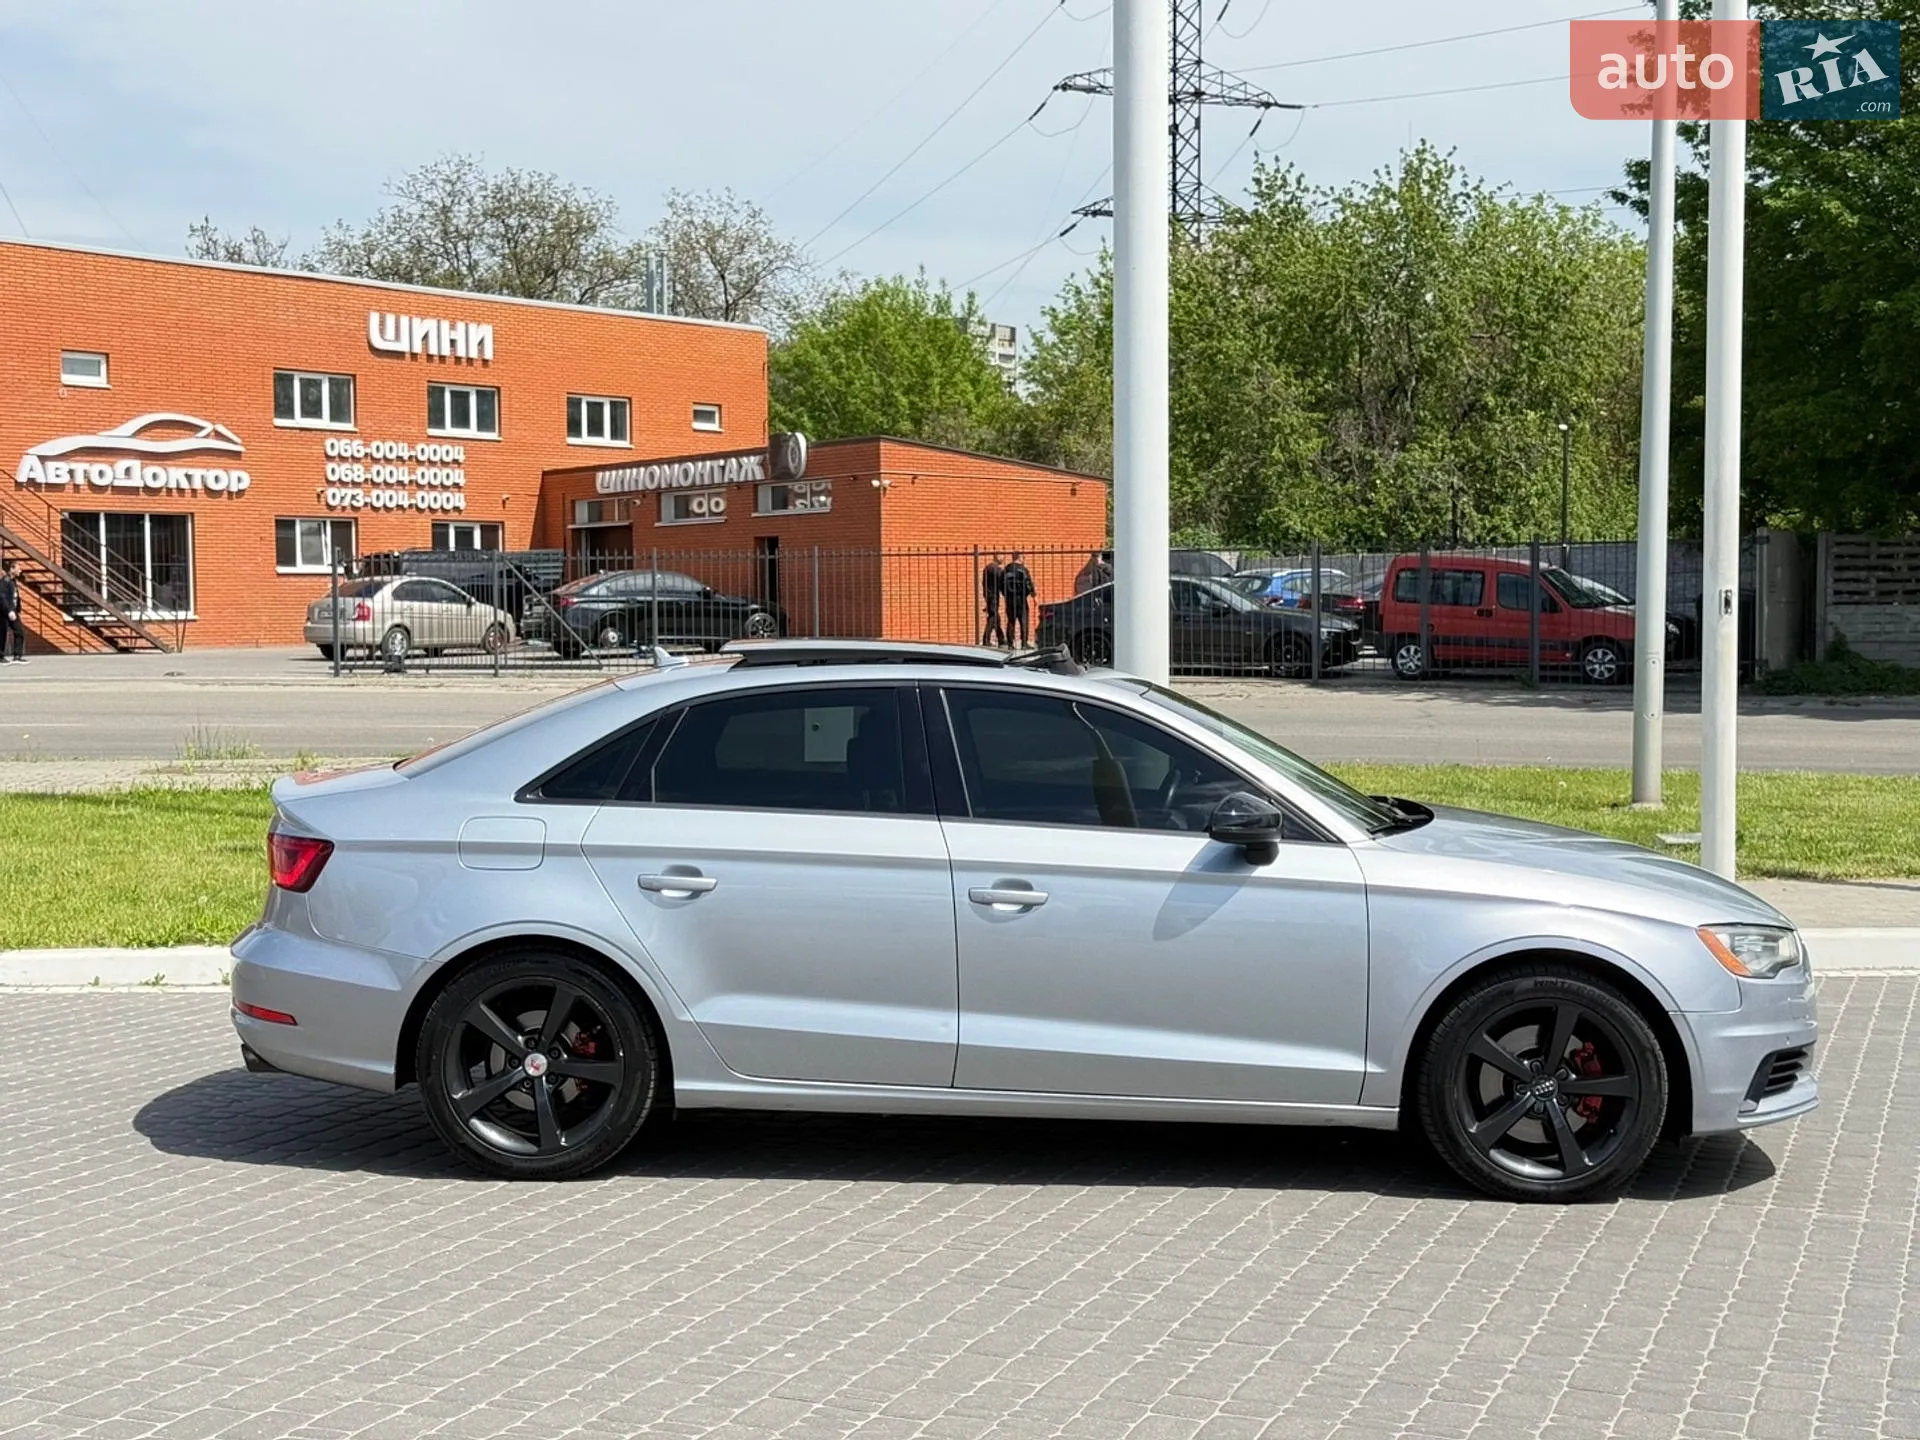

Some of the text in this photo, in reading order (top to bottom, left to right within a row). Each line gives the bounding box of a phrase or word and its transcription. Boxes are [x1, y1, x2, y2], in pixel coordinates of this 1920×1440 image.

[369, 311, 493, 360] ШИНИ
[325, 438, 465, 463] 066-004-0004
[16, 454, 251, 492] АвтоДоктор
[326, 462, 465, 486] 068-004-0004
[595, 454, 766, 494] ШИНОМОНТАЖ
[326, 487, 465, 510] 073-004-0004
